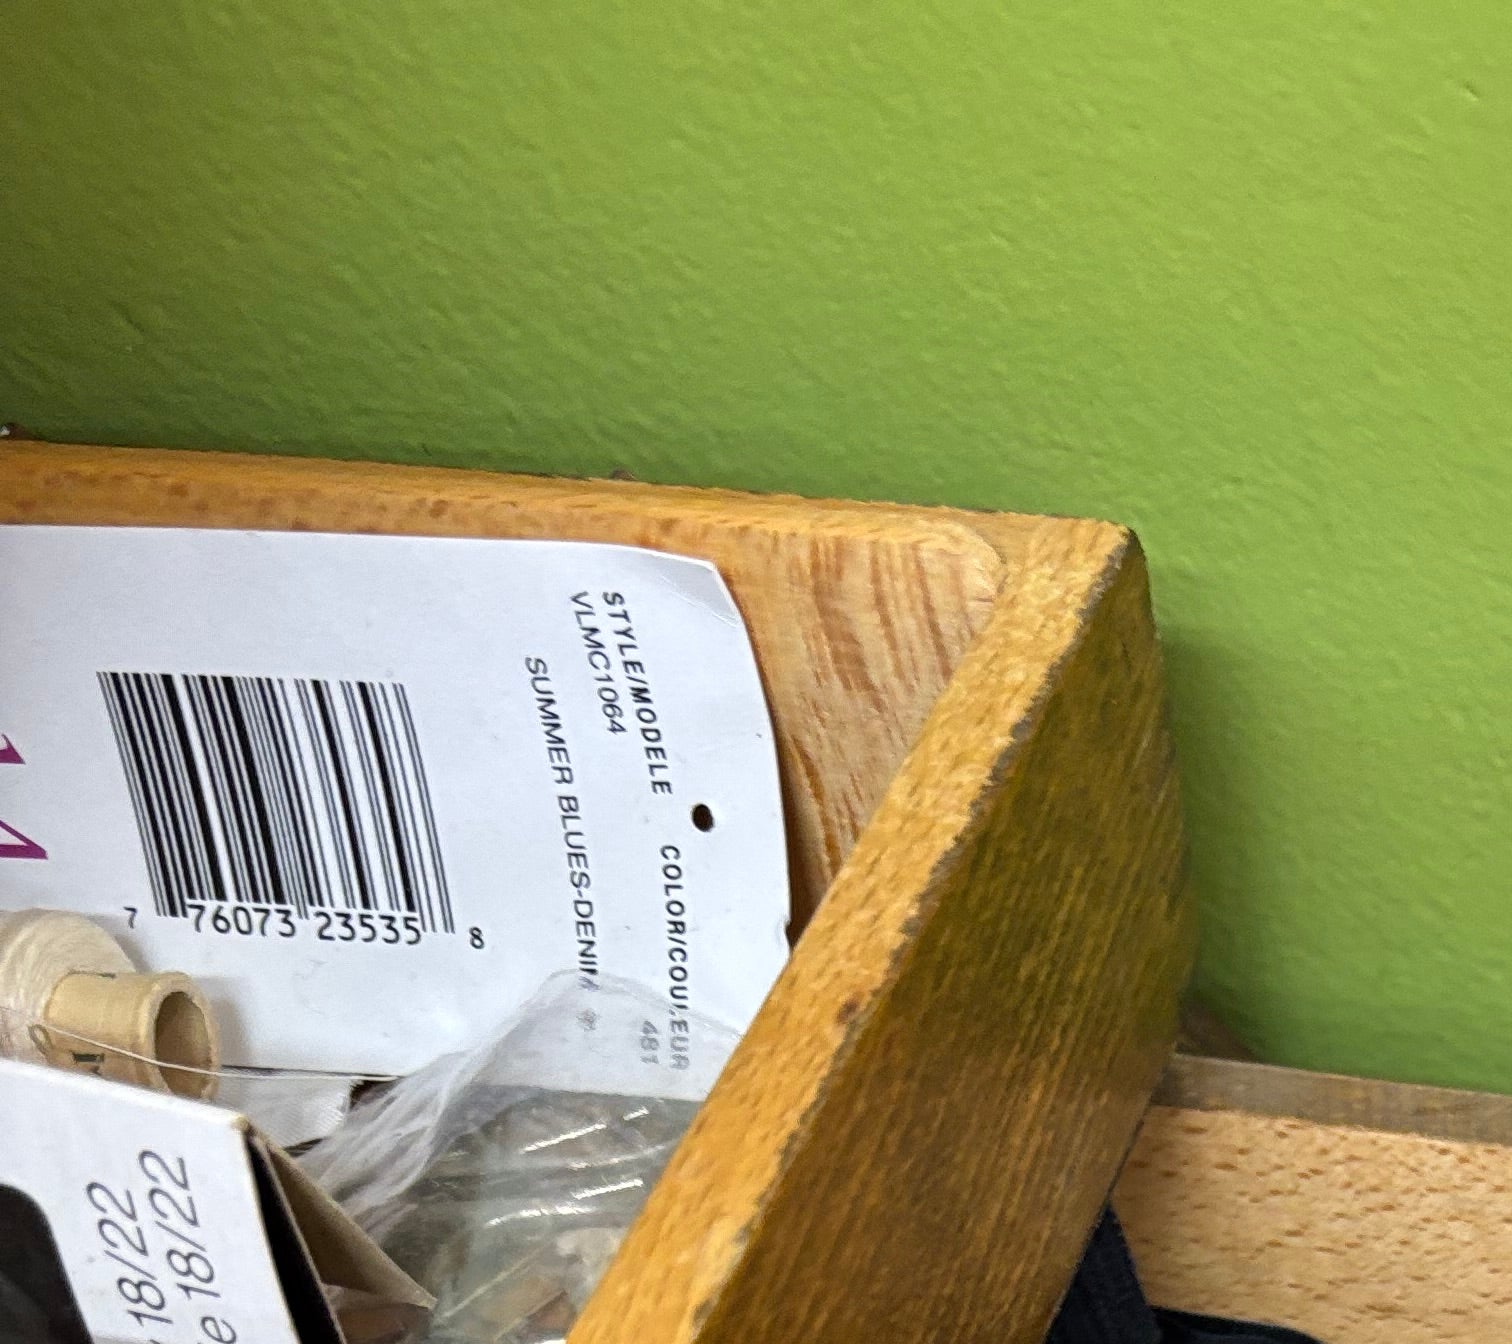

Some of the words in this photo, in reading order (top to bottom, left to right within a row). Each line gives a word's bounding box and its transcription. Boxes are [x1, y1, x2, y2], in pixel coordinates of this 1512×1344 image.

[526, 656, 574, 785] SUMMER
[571, 591, 627, 735] VLMC1064
[601, 590, 674, 795] STYLE/MODELE
[186, 904, 298, 939] 76073
[315, 909, 423, 946] 23535
[468, 927, 486, 951] 8
[86, 1181, 173, 1327] 18/22
[138, 1149, 221, 1298] 18/22
